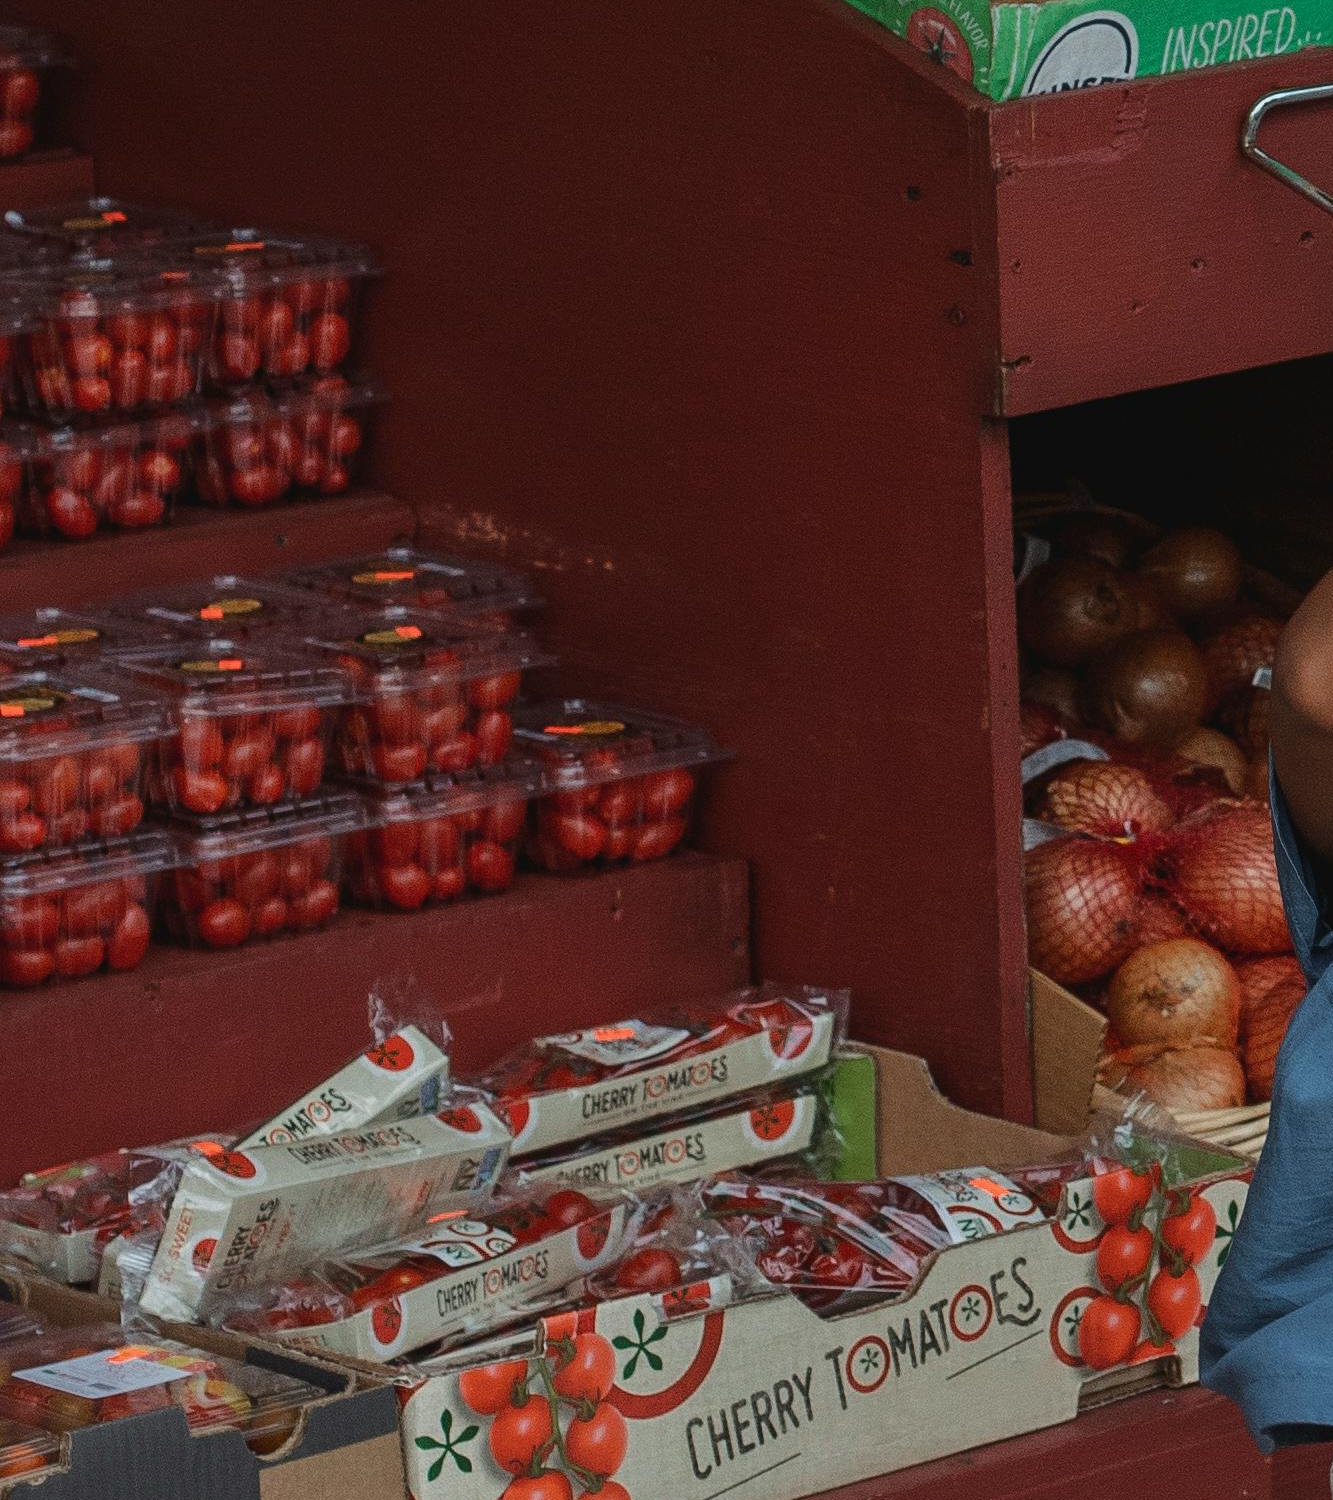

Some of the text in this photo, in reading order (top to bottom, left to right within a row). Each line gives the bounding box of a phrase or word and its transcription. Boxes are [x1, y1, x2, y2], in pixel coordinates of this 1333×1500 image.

[581, 1053, 730, 1121] CHERRY TOMATOES
[612, 1131, 707, 1184] TOMATOES
[435, 1278, 480, 1318] CHERRY
[479, 1248, 549, 1299] TOMATOES
[685, 1255, 1043, 1481] CHERRY TOMATOES
